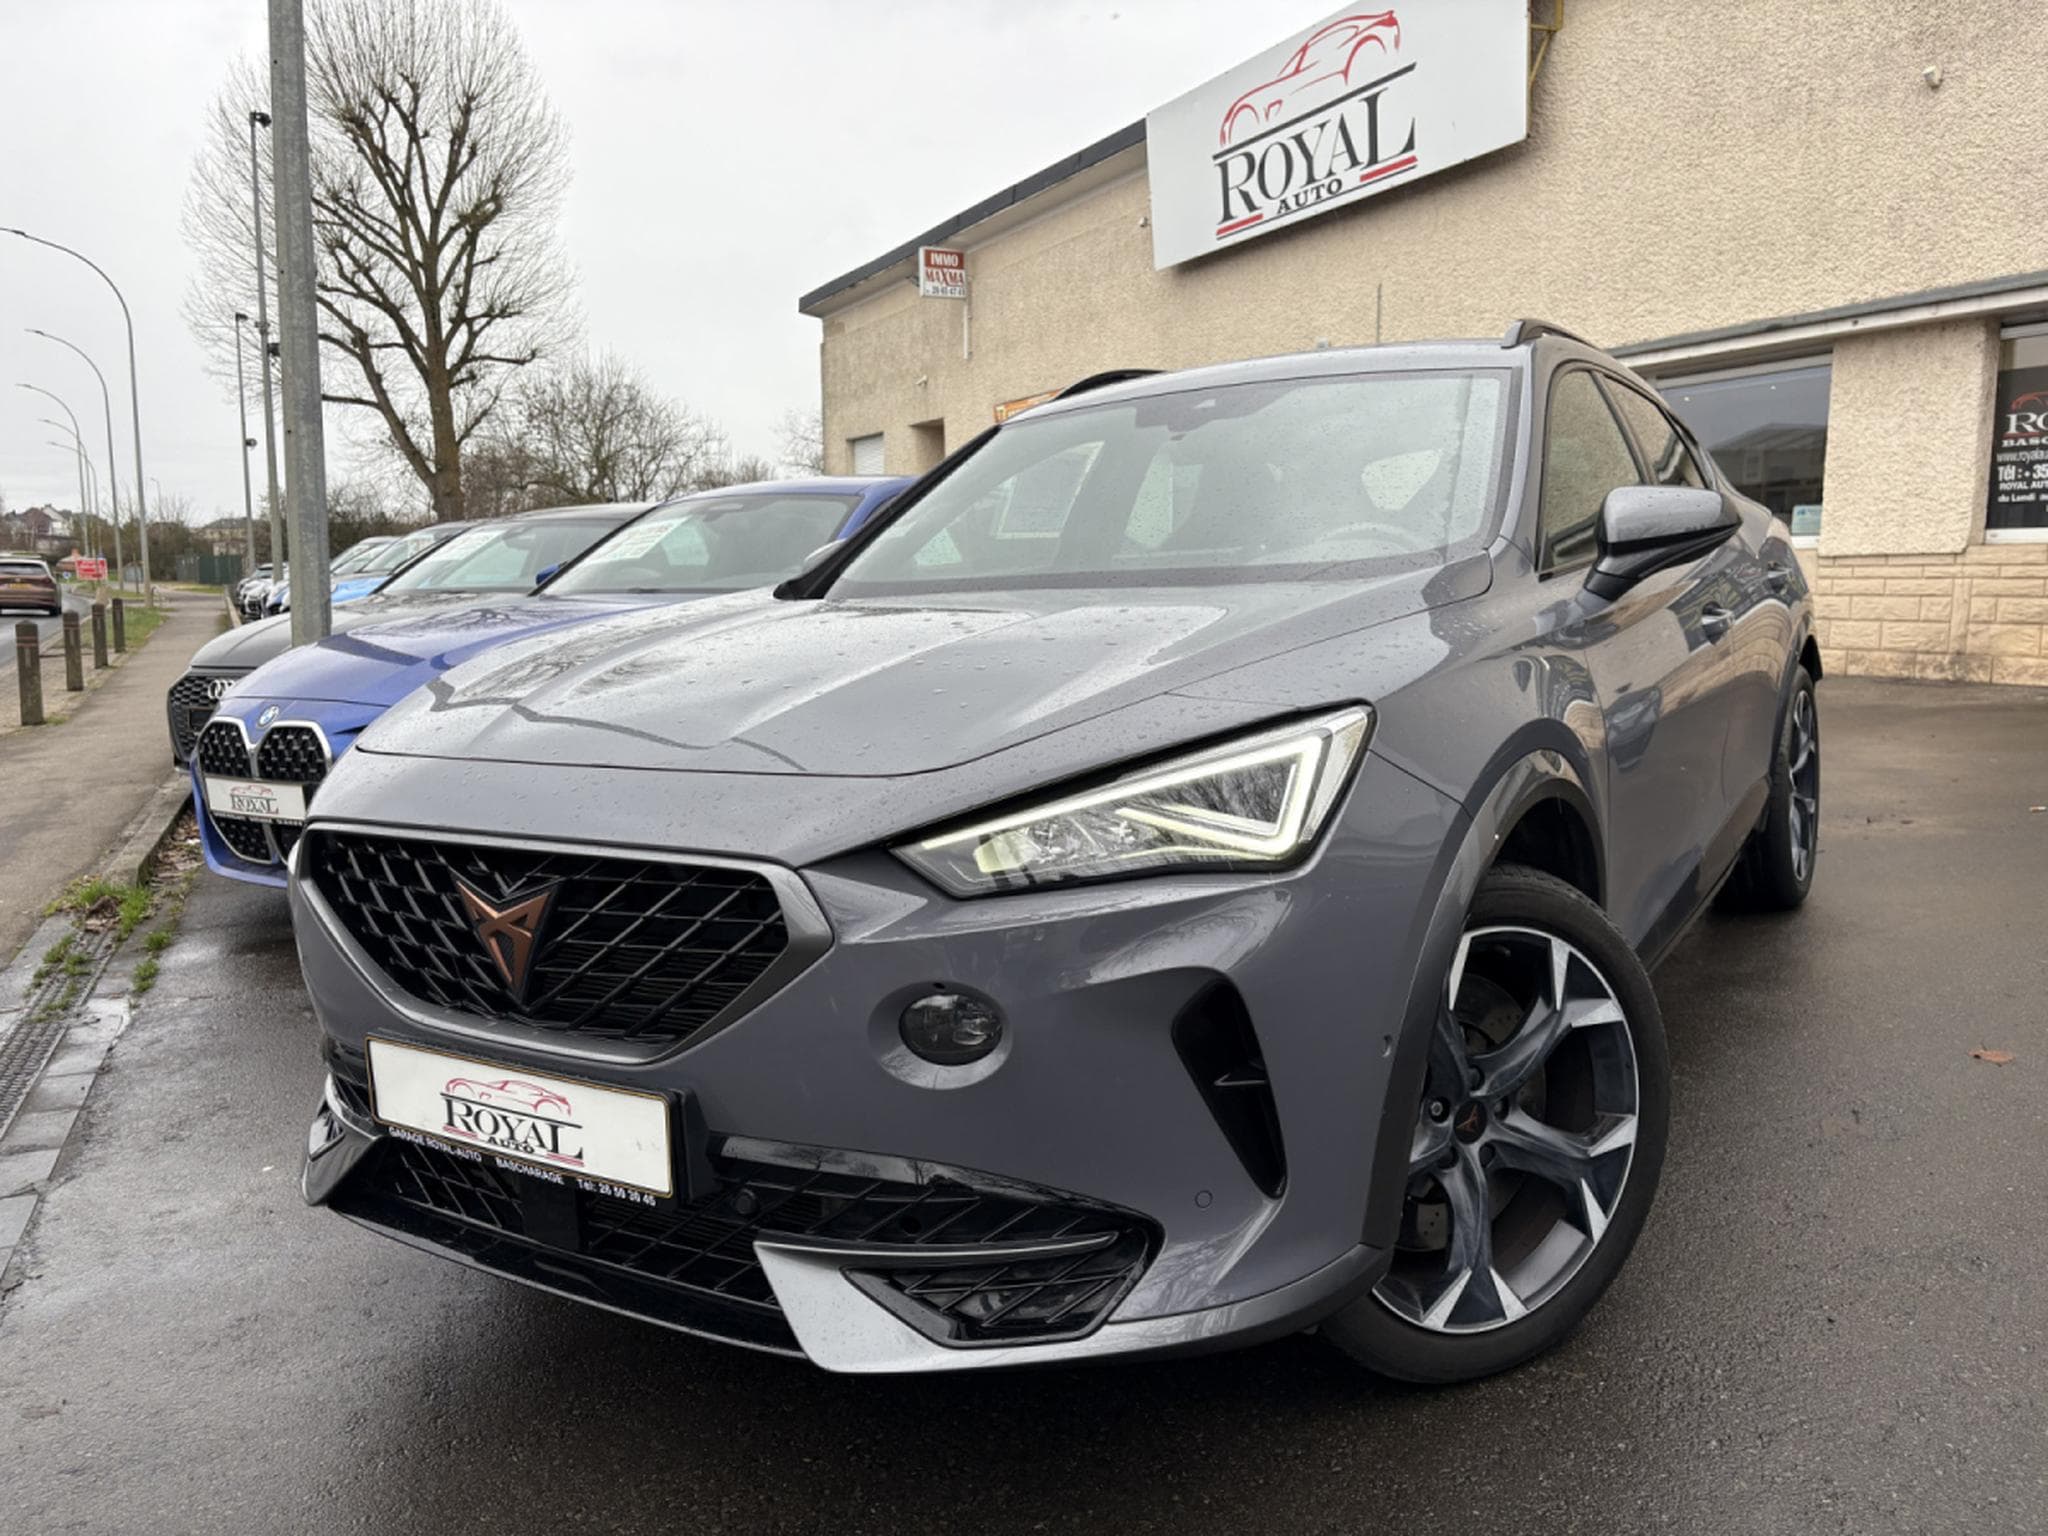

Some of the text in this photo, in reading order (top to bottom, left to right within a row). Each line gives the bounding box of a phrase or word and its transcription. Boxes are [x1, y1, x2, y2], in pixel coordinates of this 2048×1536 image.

[1214, 88, 1416, 226] ROYAL
[1276, 178, 1343, 215] AUTO
[930, 252, 959, 267] IMMO
[231, 795, 279, 815] ROYAL
[444, 1096, 583, 1160] ROYAL
[486, 1135, 535, 1154] AUTO
